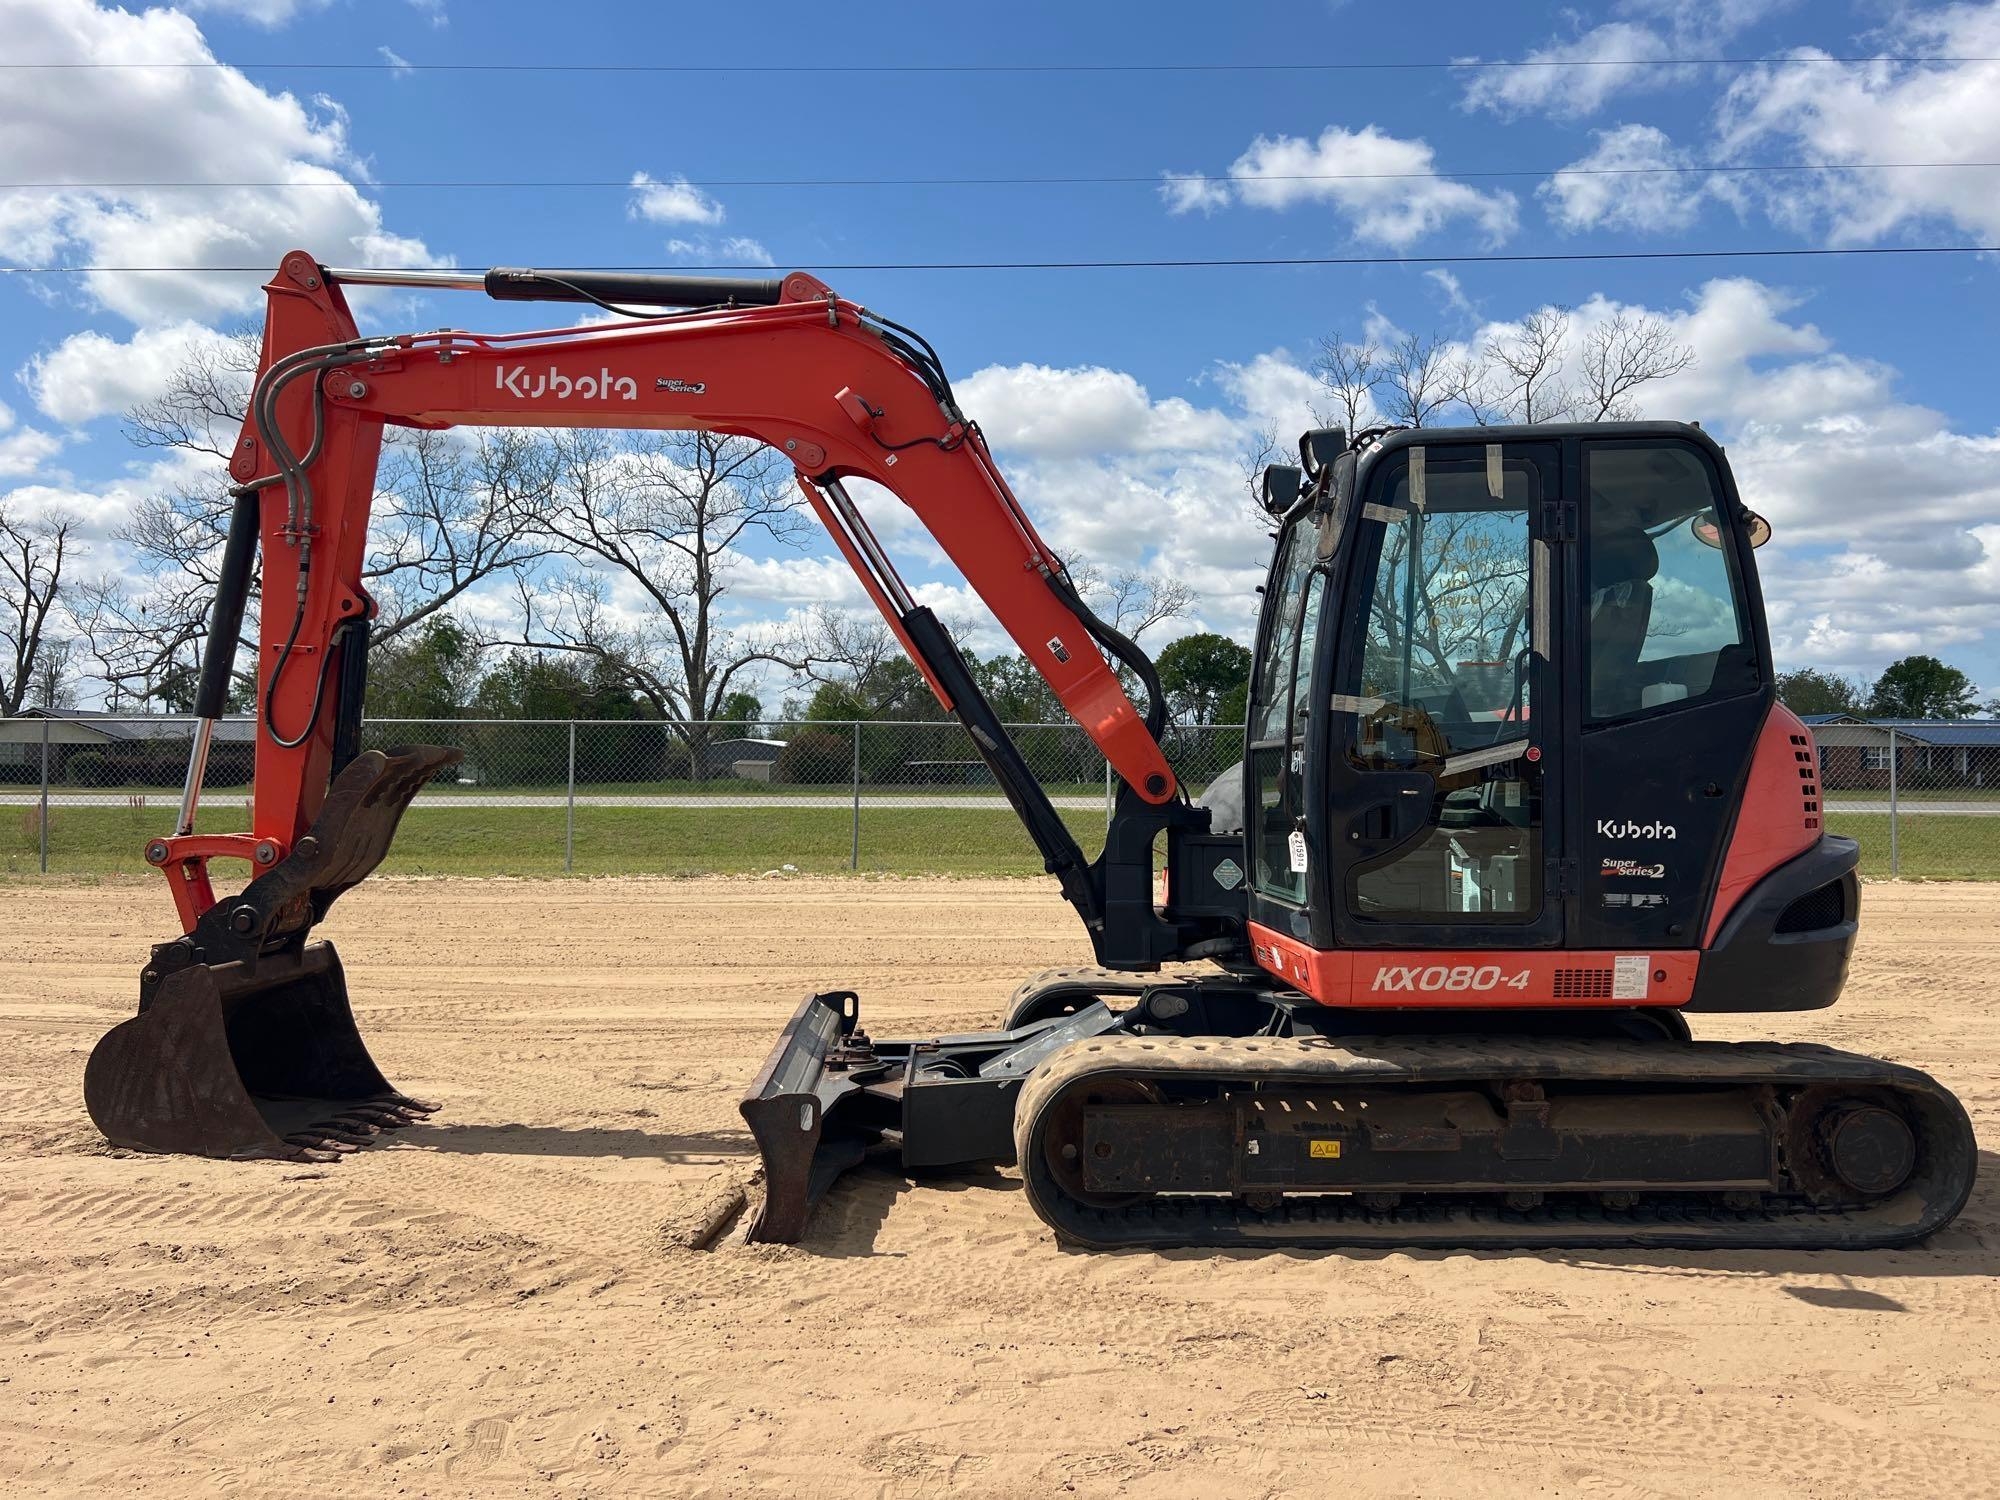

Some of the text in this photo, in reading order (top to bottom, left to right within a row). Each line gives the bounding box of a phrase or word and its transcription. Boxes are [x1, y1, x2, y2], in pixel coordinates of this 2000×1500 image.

[496, 366, 637, 400] Kubota
[656, 378, 684, 387] Super
[1597, 820, 1677, 839] Kubota
[1294, 839, 1305, 867] 215914
[1602, 858, 1637, 869] Super
[1371, 966, 1531, 990] KX080-4
